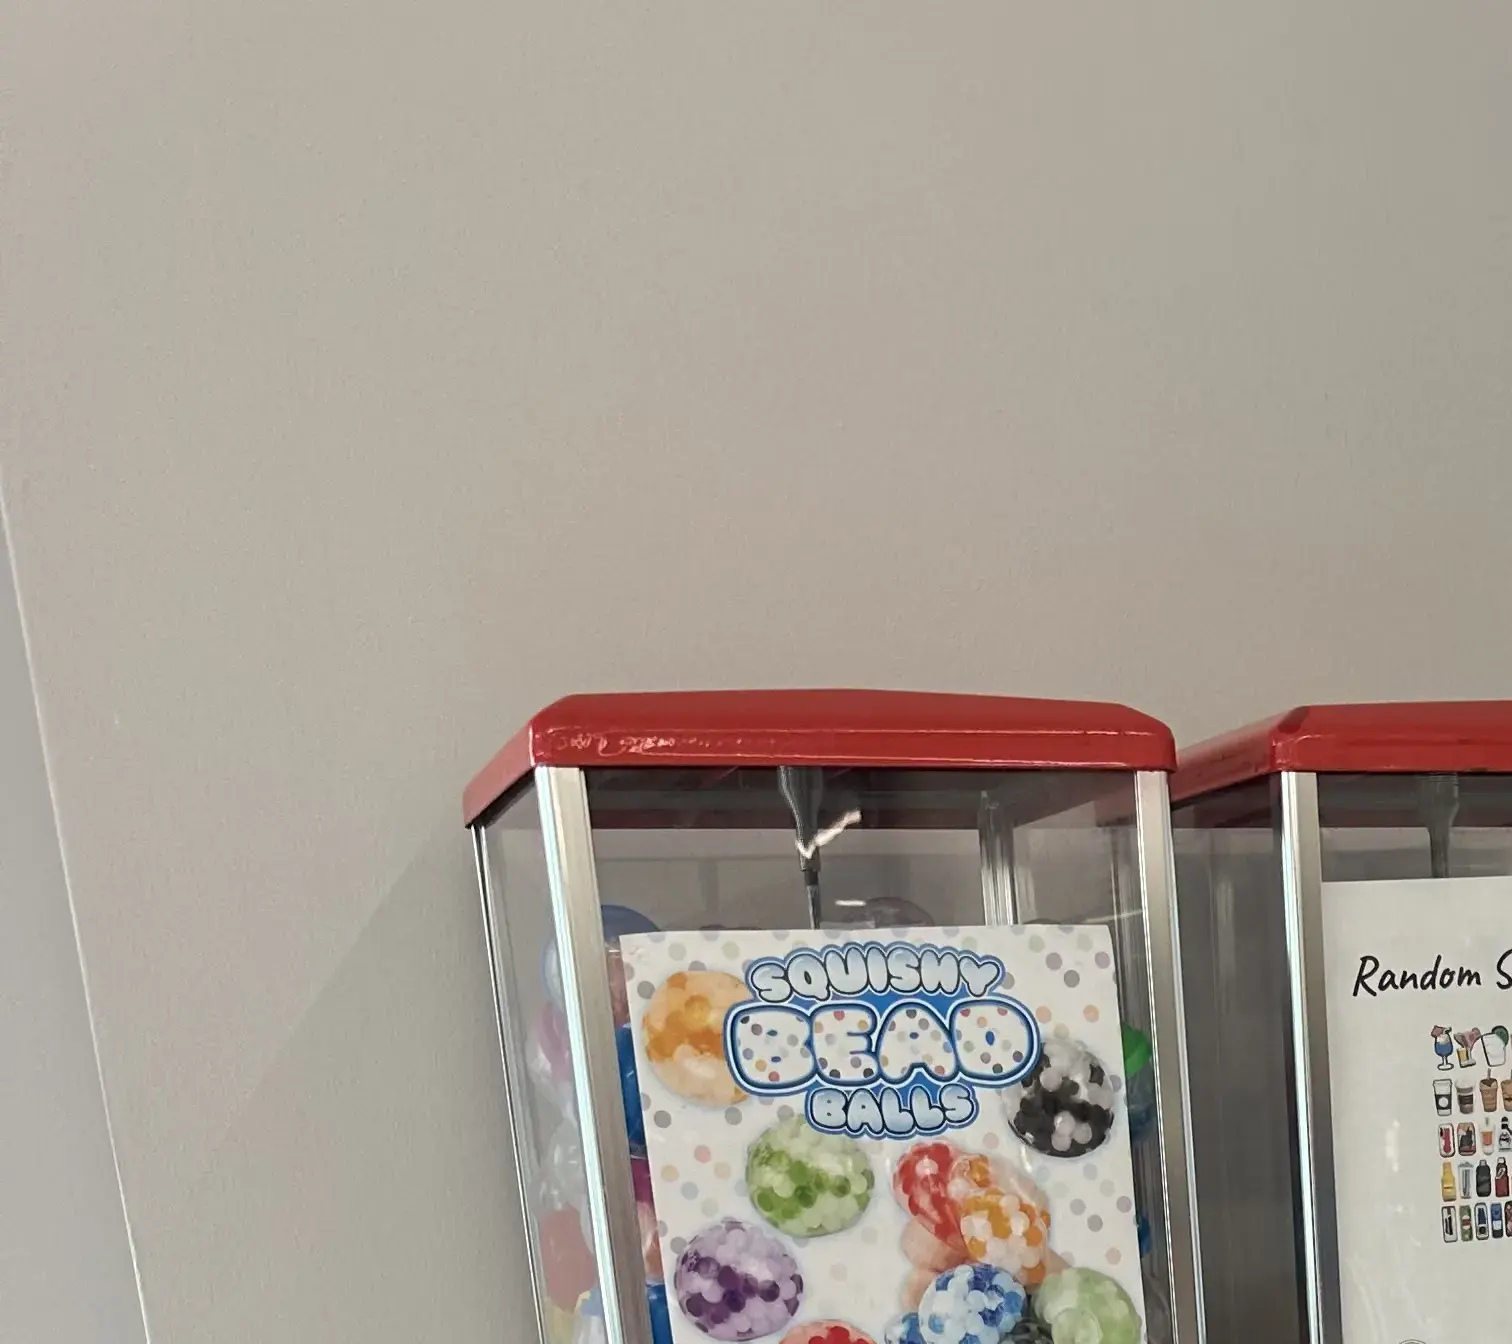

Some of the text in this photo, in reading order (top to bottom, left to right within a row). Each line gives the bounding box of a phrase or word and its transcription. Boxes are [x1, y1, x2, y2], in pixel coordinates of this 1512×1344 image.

[750, 946, 1002, 1004] SQUISHY
[1352, 955, 1482, 997] Random
[731, 1001, 1036, 1090] BEAD
[809, 1083, 975, 1135] BALLS
